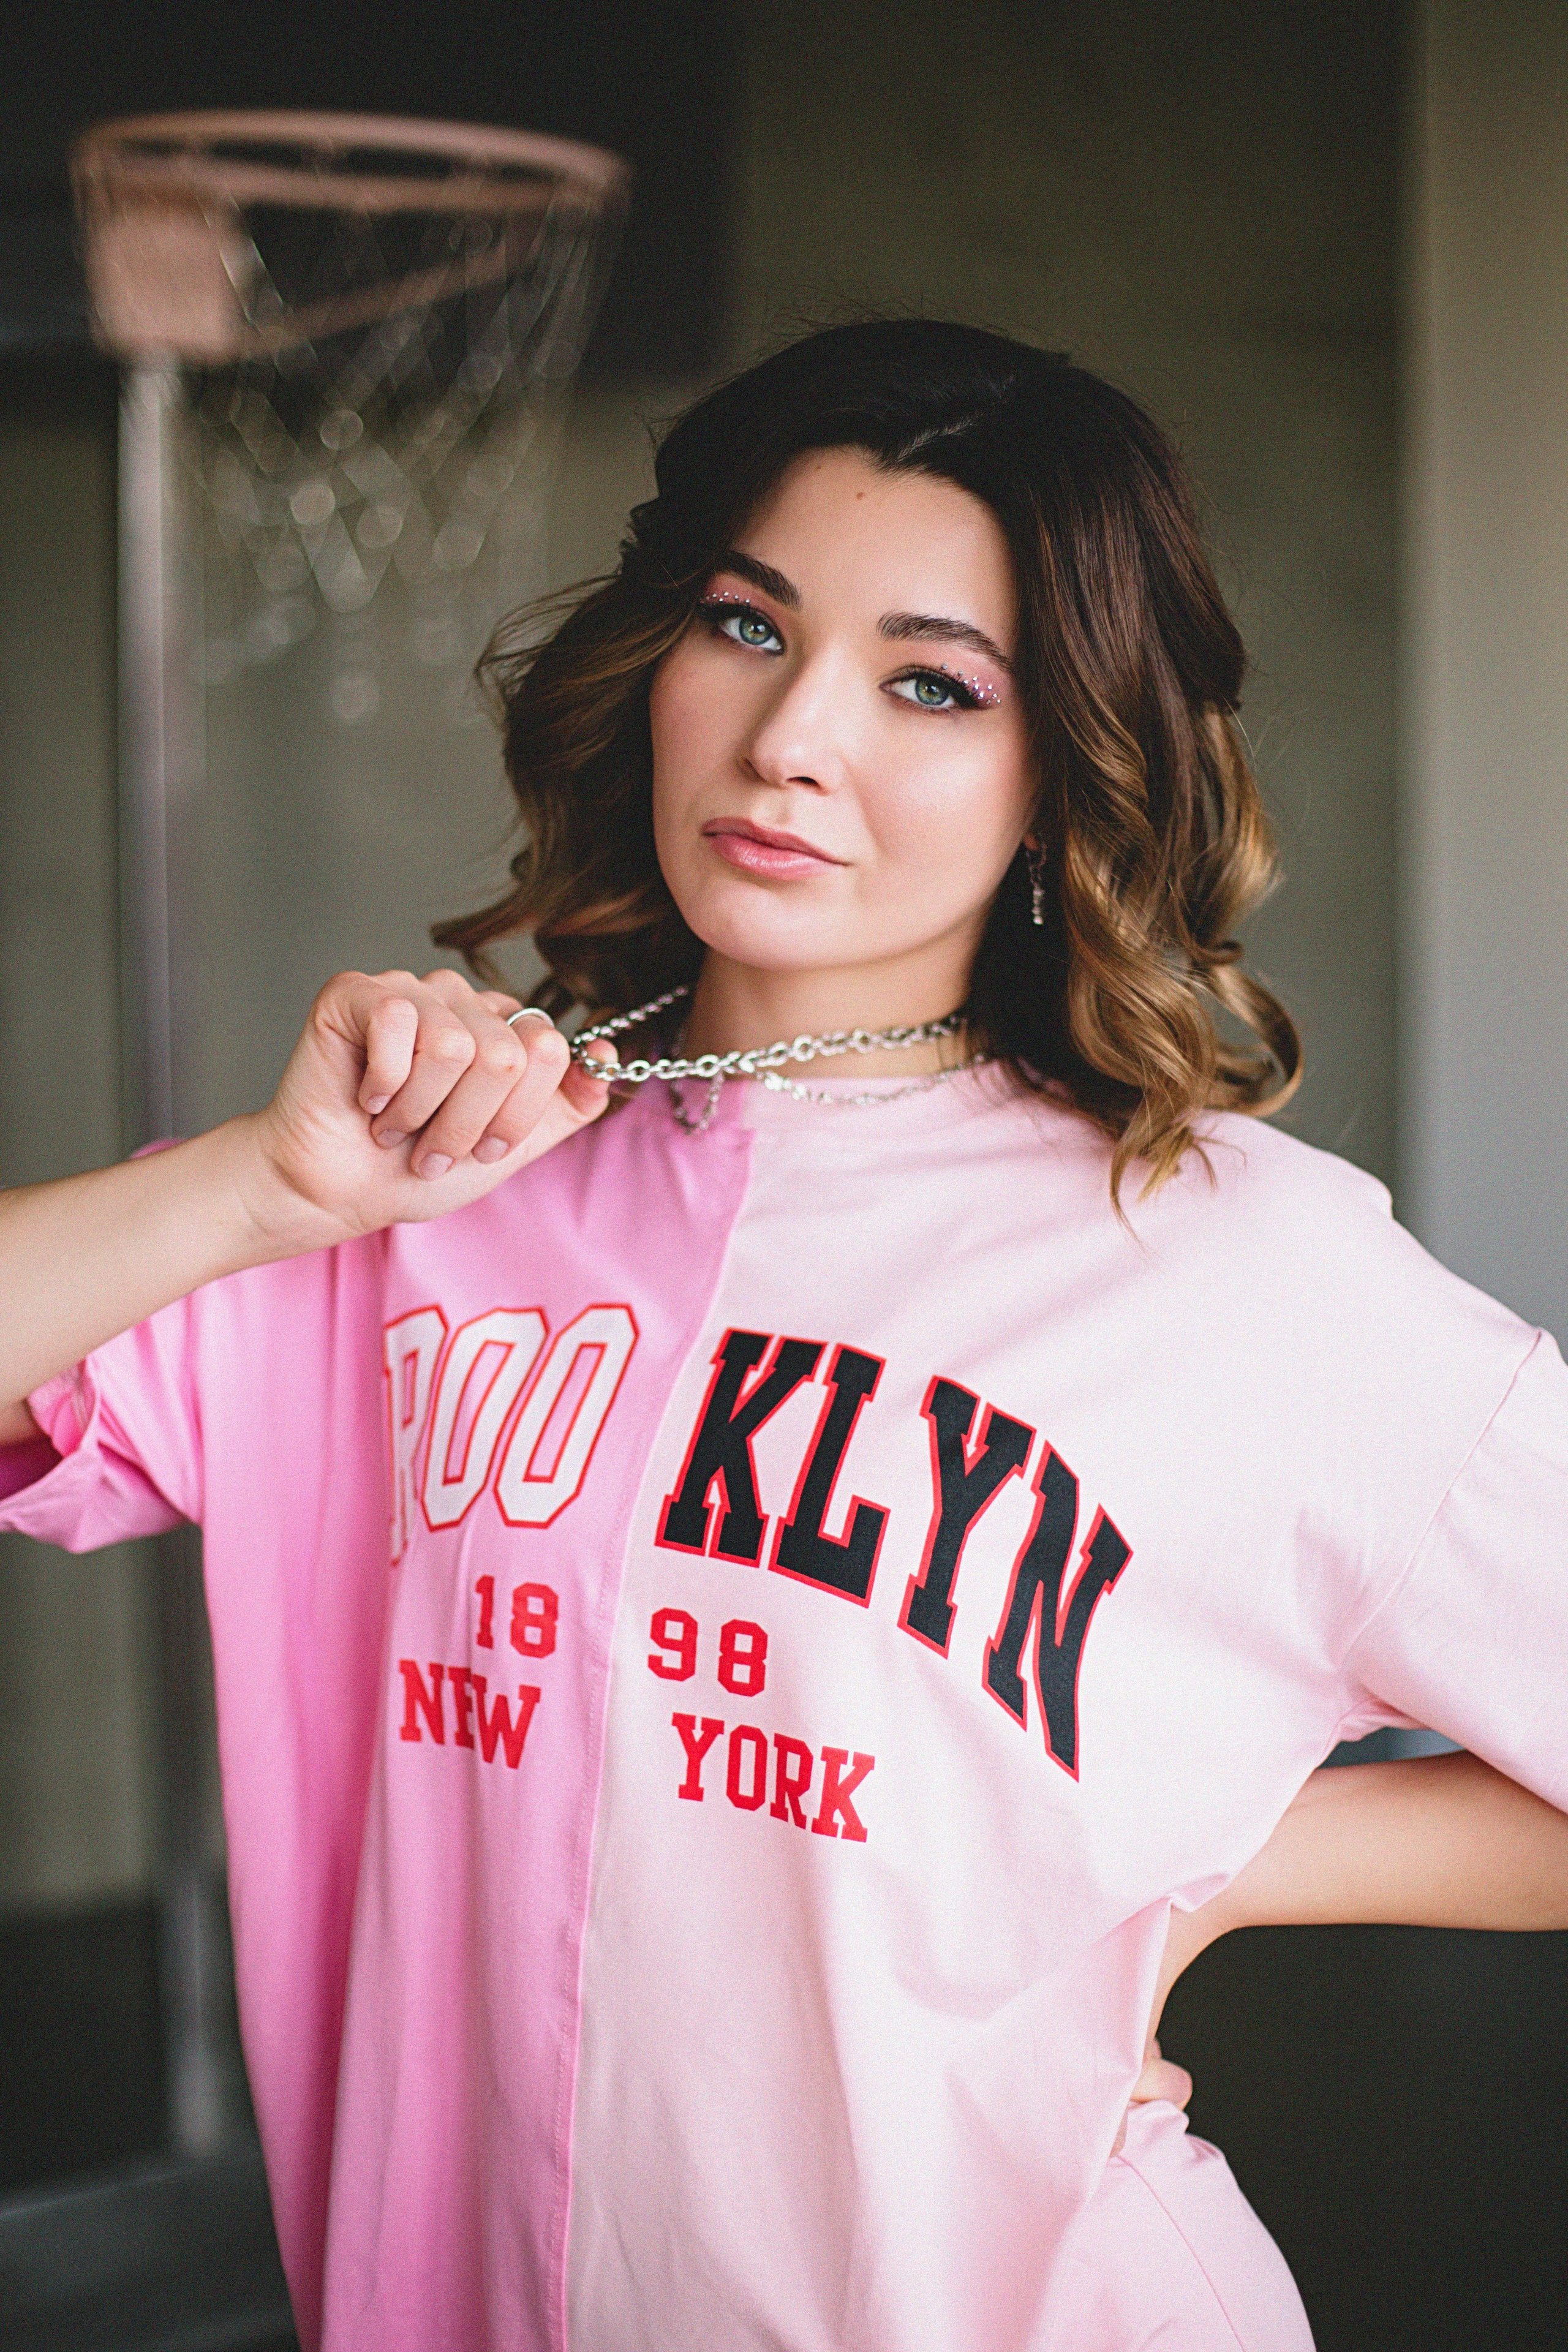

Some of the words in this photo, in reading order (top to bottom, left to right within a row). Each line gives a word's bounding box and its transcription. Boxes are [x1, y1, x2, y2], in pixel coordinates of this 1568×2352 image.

[475, 1574, 558, 1659] 18
[648, 1607, 768, 1697] 98
[671, 1712, 875, 1842] YORK
